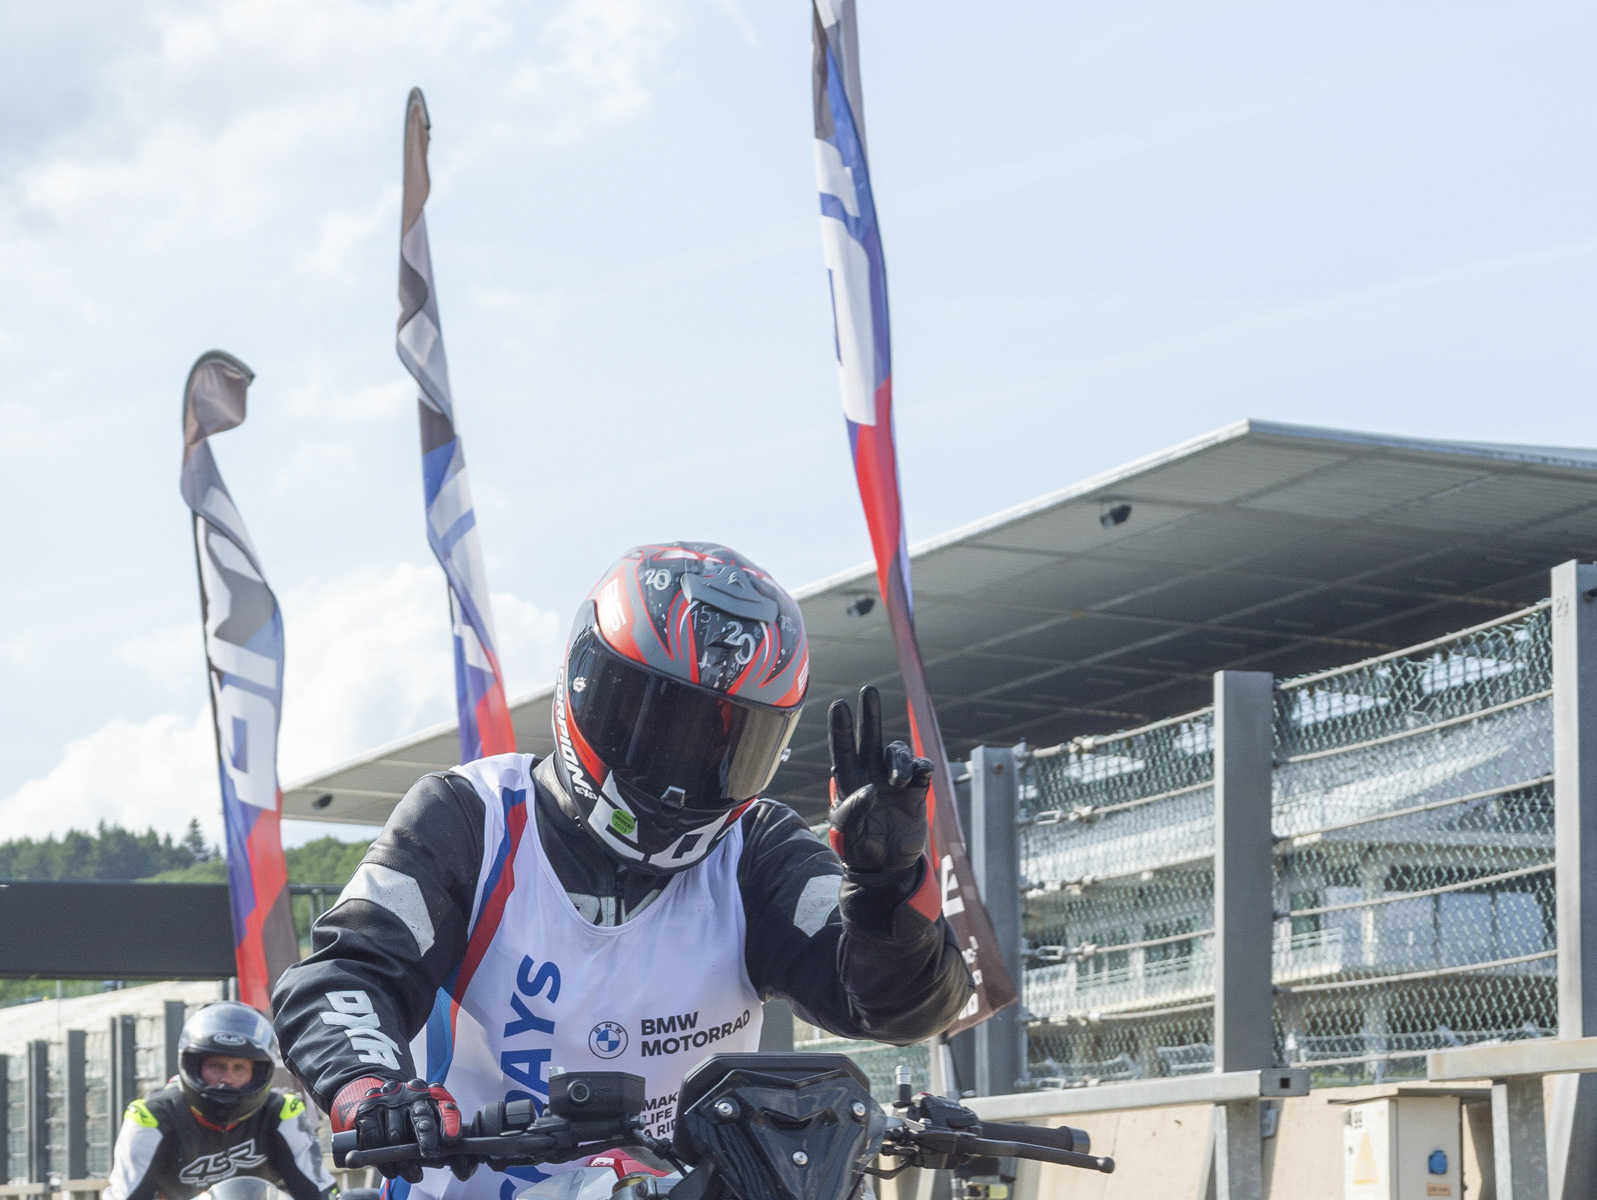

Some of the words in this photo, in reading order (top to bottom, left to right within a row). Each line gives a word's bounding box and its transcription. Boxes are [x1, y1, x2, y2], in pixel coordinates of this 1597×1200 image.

[645, 567, 672, 591] 20
[724, 620, 756, 665] 20
[556, 666, 594, 792] CORPION
[641, 1011, 699, 1036] BMW
[641, 1009, 750, 1057] MOTORRAD
[643, 1091, 679, 1112] MAK
[643, 1106, 673, 1126] LIFE
